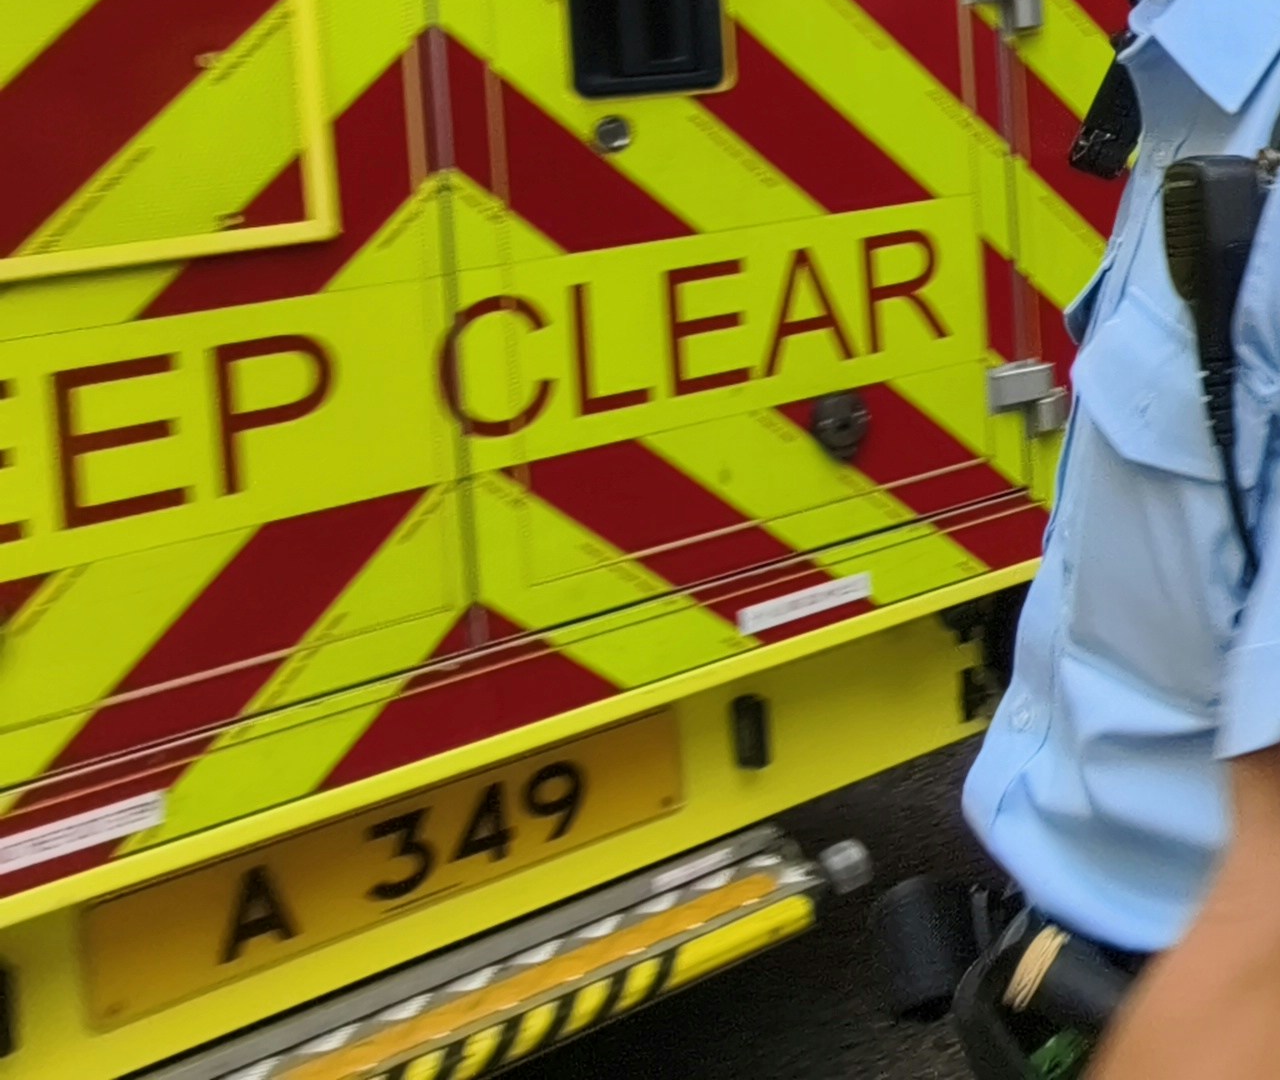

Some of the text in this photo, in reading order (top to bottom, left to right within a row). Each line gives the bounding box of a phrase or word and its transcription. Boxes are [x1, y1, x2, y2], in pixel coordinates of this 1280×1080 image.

[0, 230, 951, 542] EP CLEAR
[218, 760, 586, 964] A 349
